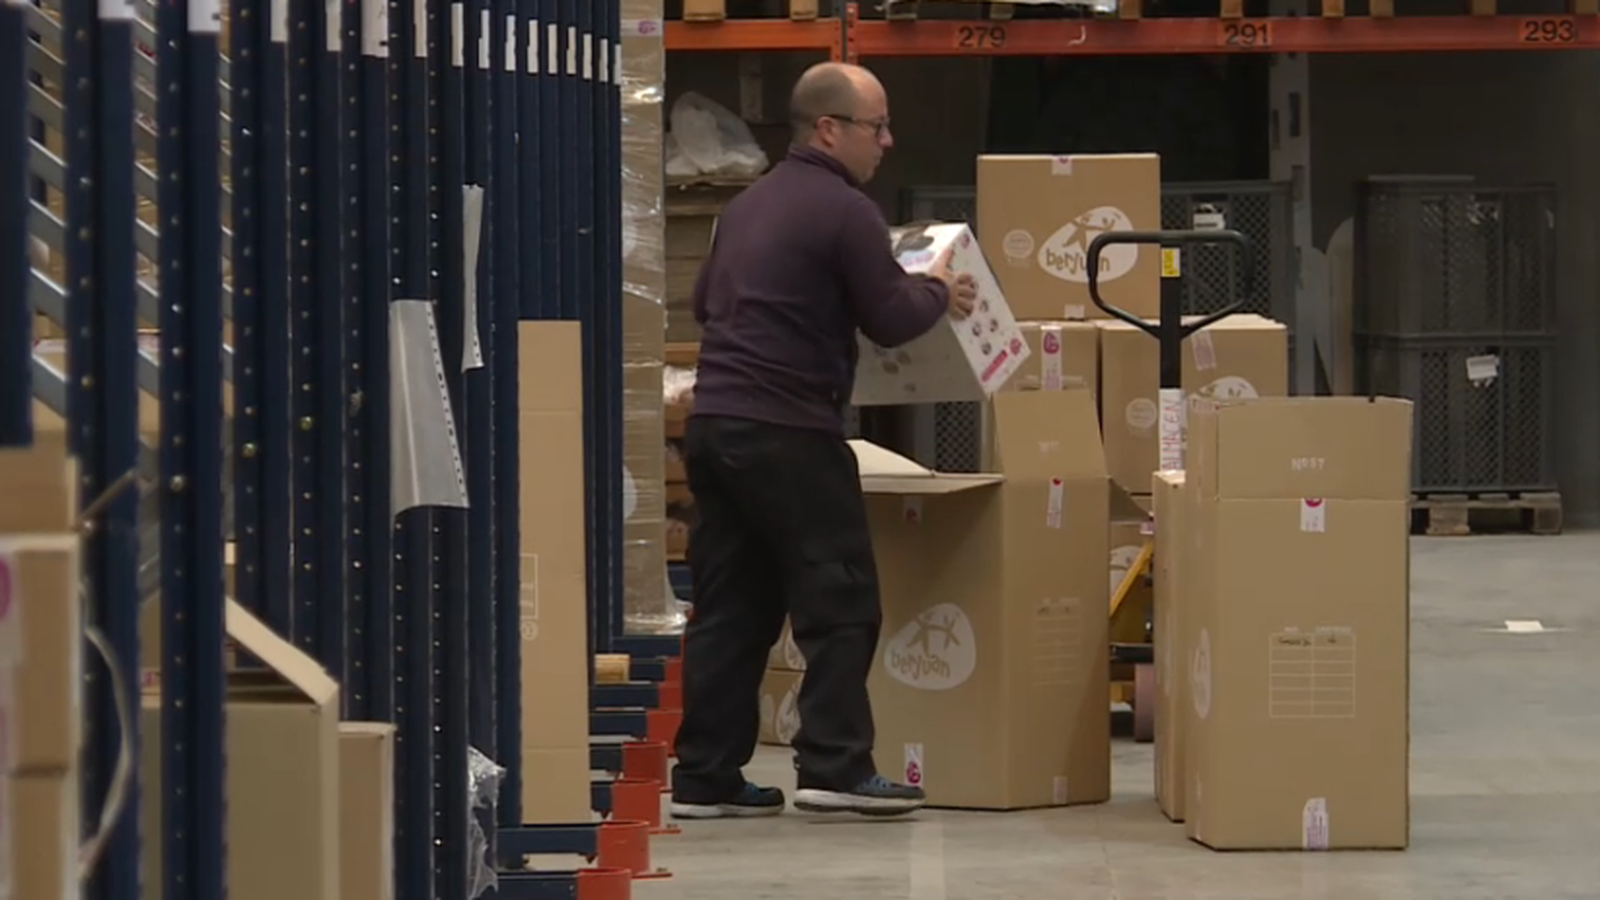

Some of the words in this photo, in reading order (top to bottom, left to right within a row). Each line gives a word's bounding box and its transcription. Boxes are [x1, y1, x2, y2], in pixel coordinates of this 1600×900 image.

[958, 26, 1006, 48] 279
[1225, 23, 1268, 45] 291
[1525, 20, 1574, 42] 293
[1045, 247, 1110, 275] berjun
[891, 648, 951, 680] berjuan
